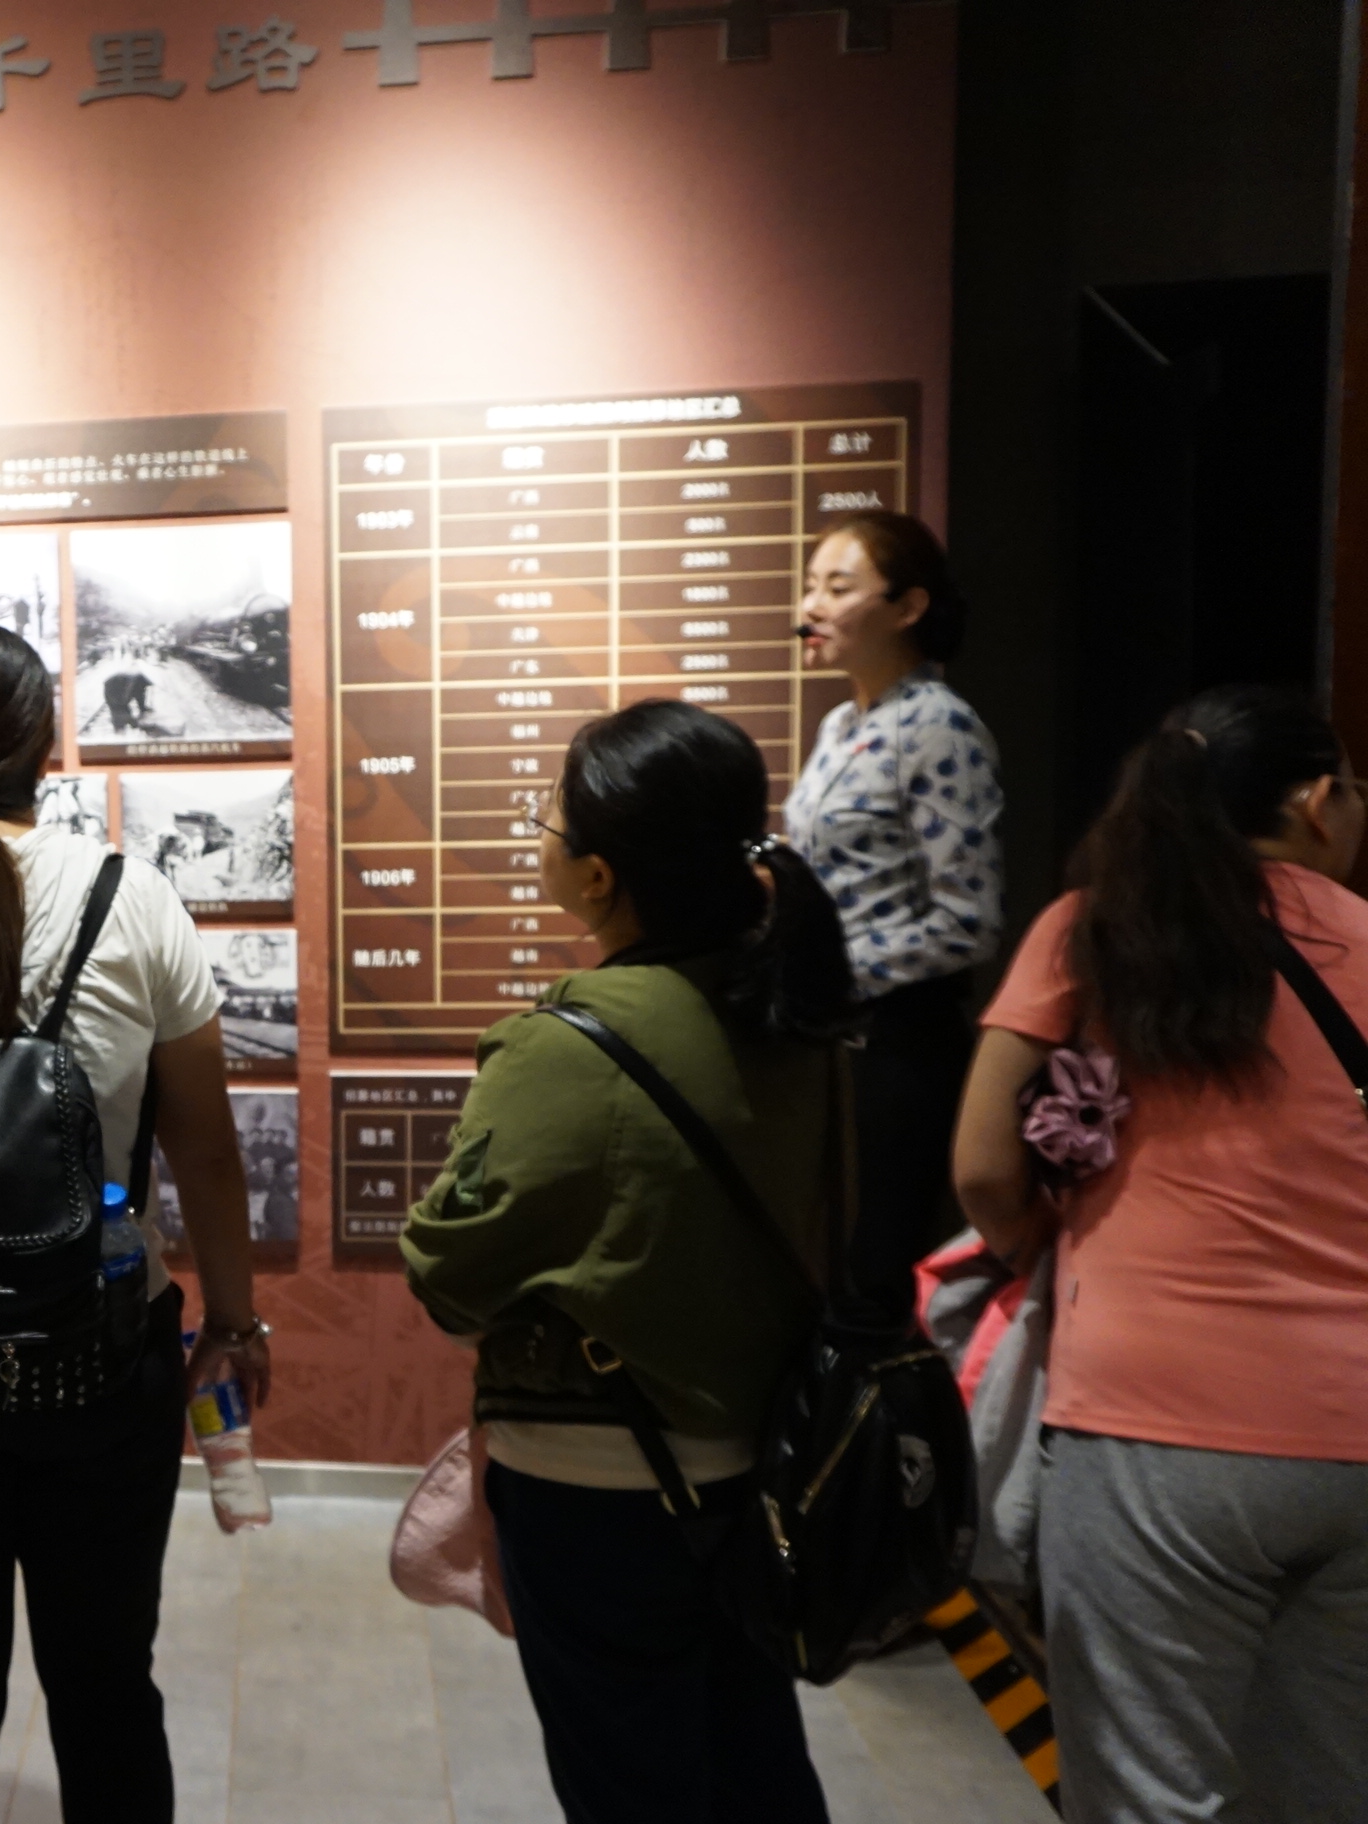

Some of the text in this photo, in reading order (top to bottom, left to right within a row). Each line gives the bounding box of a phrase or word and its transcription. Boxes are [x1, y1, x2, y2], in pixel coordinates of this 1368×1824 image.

[818, 490, 883, 512] 2500人
[357, 608, 415, 630] 1904年
[359, 755, 417, 775] 1905年
[361, 868, 416, 887] 1906年
[352, 948, 422, 968] 随后几年
[360, 1179, 395, 1198] 人数
